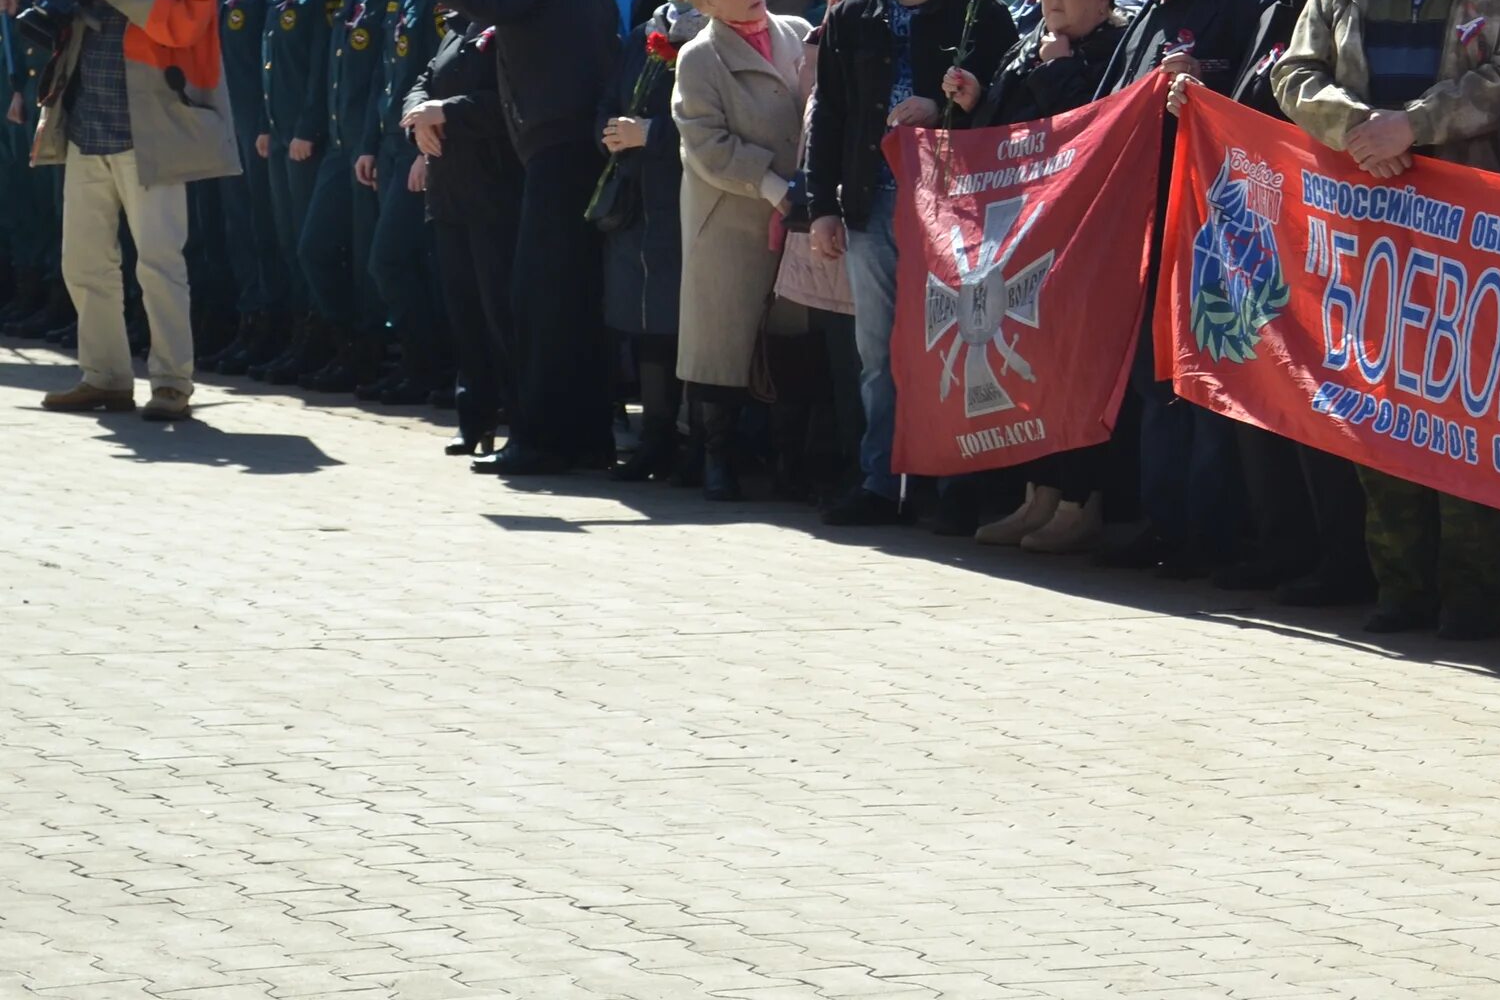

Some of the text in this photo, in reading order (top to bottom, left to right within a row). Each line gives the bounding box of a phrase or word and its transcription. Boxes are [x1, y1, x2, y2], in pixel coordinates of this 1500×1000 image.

[996, 131, 1046, 161] СОЮЗ
[1231, 147, 1284, 189] Боевое
[1302, 168, 1465, 243] ВСЕРОССИЙСКАЯ
[956, 417, 1046, 460] ДОНБАССА
[1313, 381, 1479, 465] КИРОВСКОЕ
